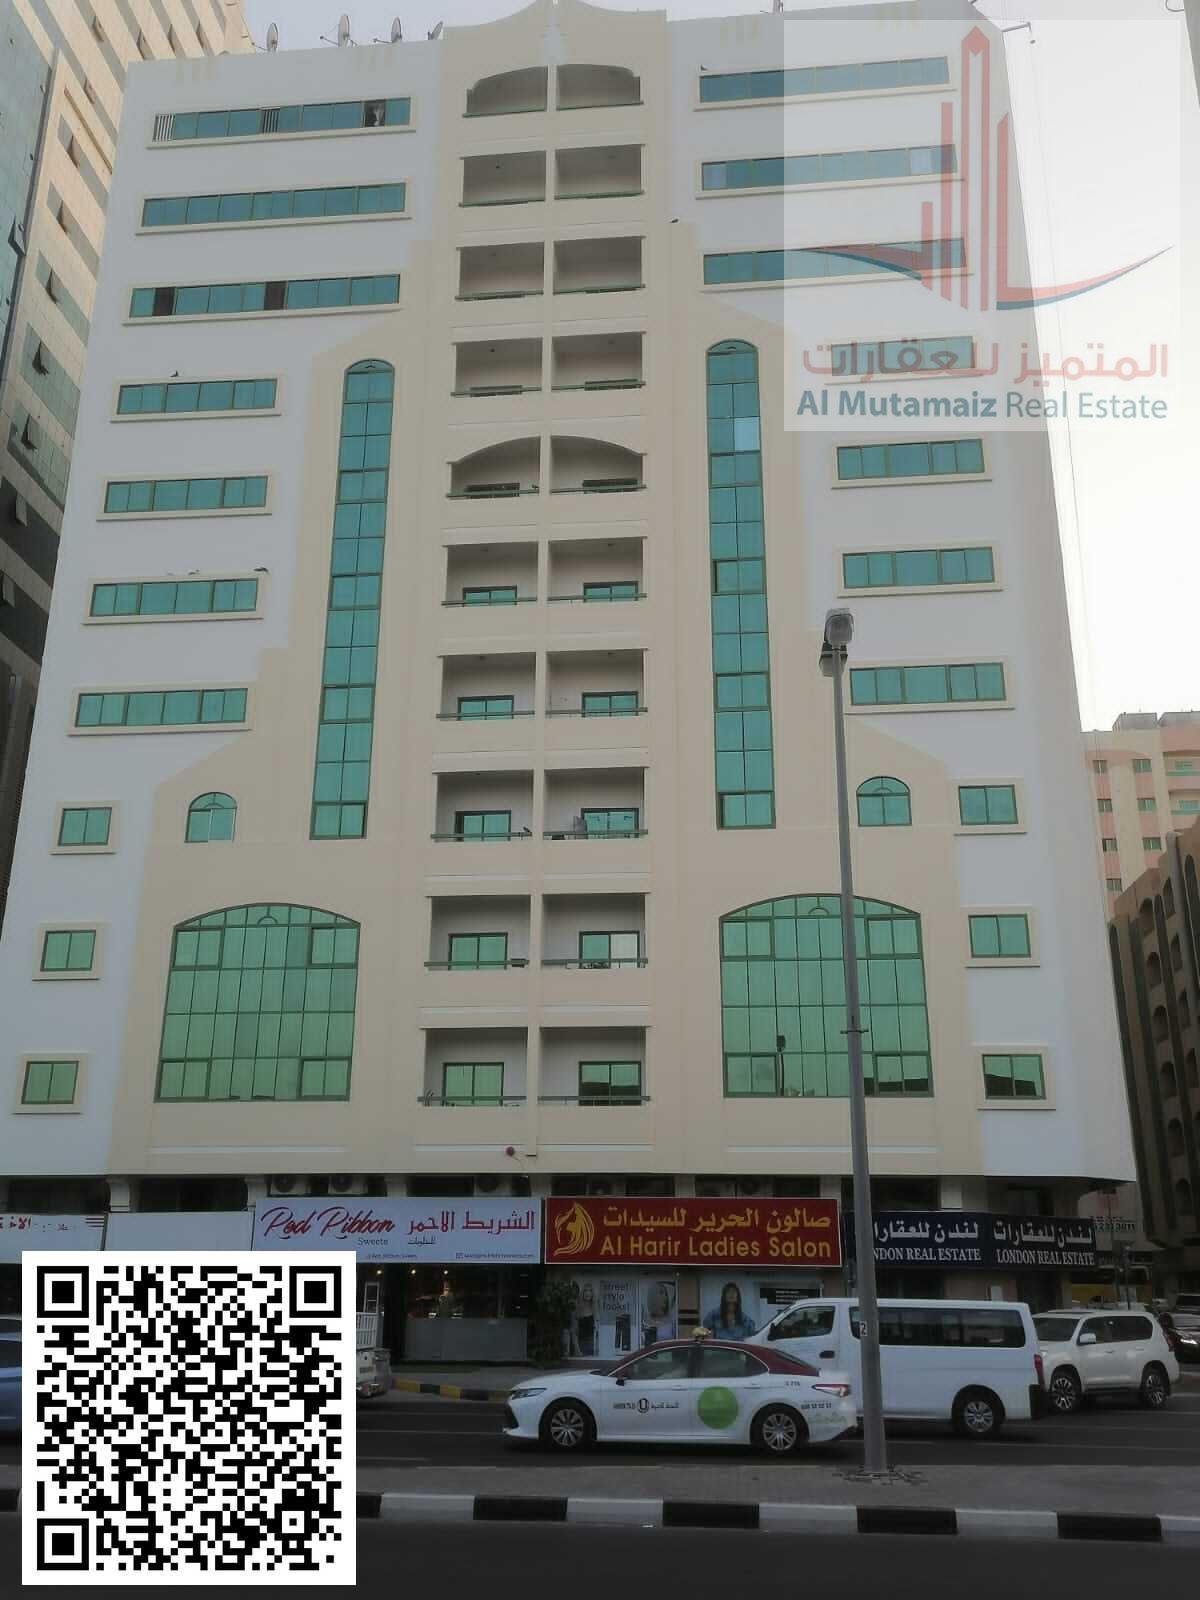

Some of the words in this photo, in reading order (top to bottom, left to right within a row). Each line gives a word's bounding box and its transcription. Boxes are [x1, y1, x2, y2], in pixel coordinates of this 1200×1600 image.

[316, 1206, 396, 1239] Ribbon
[407, 1210, 455, 1236] الاحمر
[462, 1209, 535, 1236] الشريط
[603, 1206, 686, 1232] للسيدات
[690, 1208, 759, 1233] الحرير
[766, 1209, 830, 1233] صالون
[874, 1219, 930, 1243] للعقارا
[935, 1222, 979, 1244] لندن
[993, 1221, 1055, 1246] للعقارات
[1058, 1224, 1092, 1249] لندن
[600, 1237, 621, 1256] Al
[630, 1237, 681, 1257] Harir
[688, 1237, 760, 1257] Ladies
[769, 1238, 831, 1258] Salon
[873, 1248, 904, 1261] NDON
[906, 1248, 937, 1261] REAL
[939, 1248, 981, 1261] ESTATE
[997, 1250, 1037, 1264] LONDON
[1038, 1251, 1061, 1265] REAL
[1062, 1252, 1095, 1266] ESTATE
